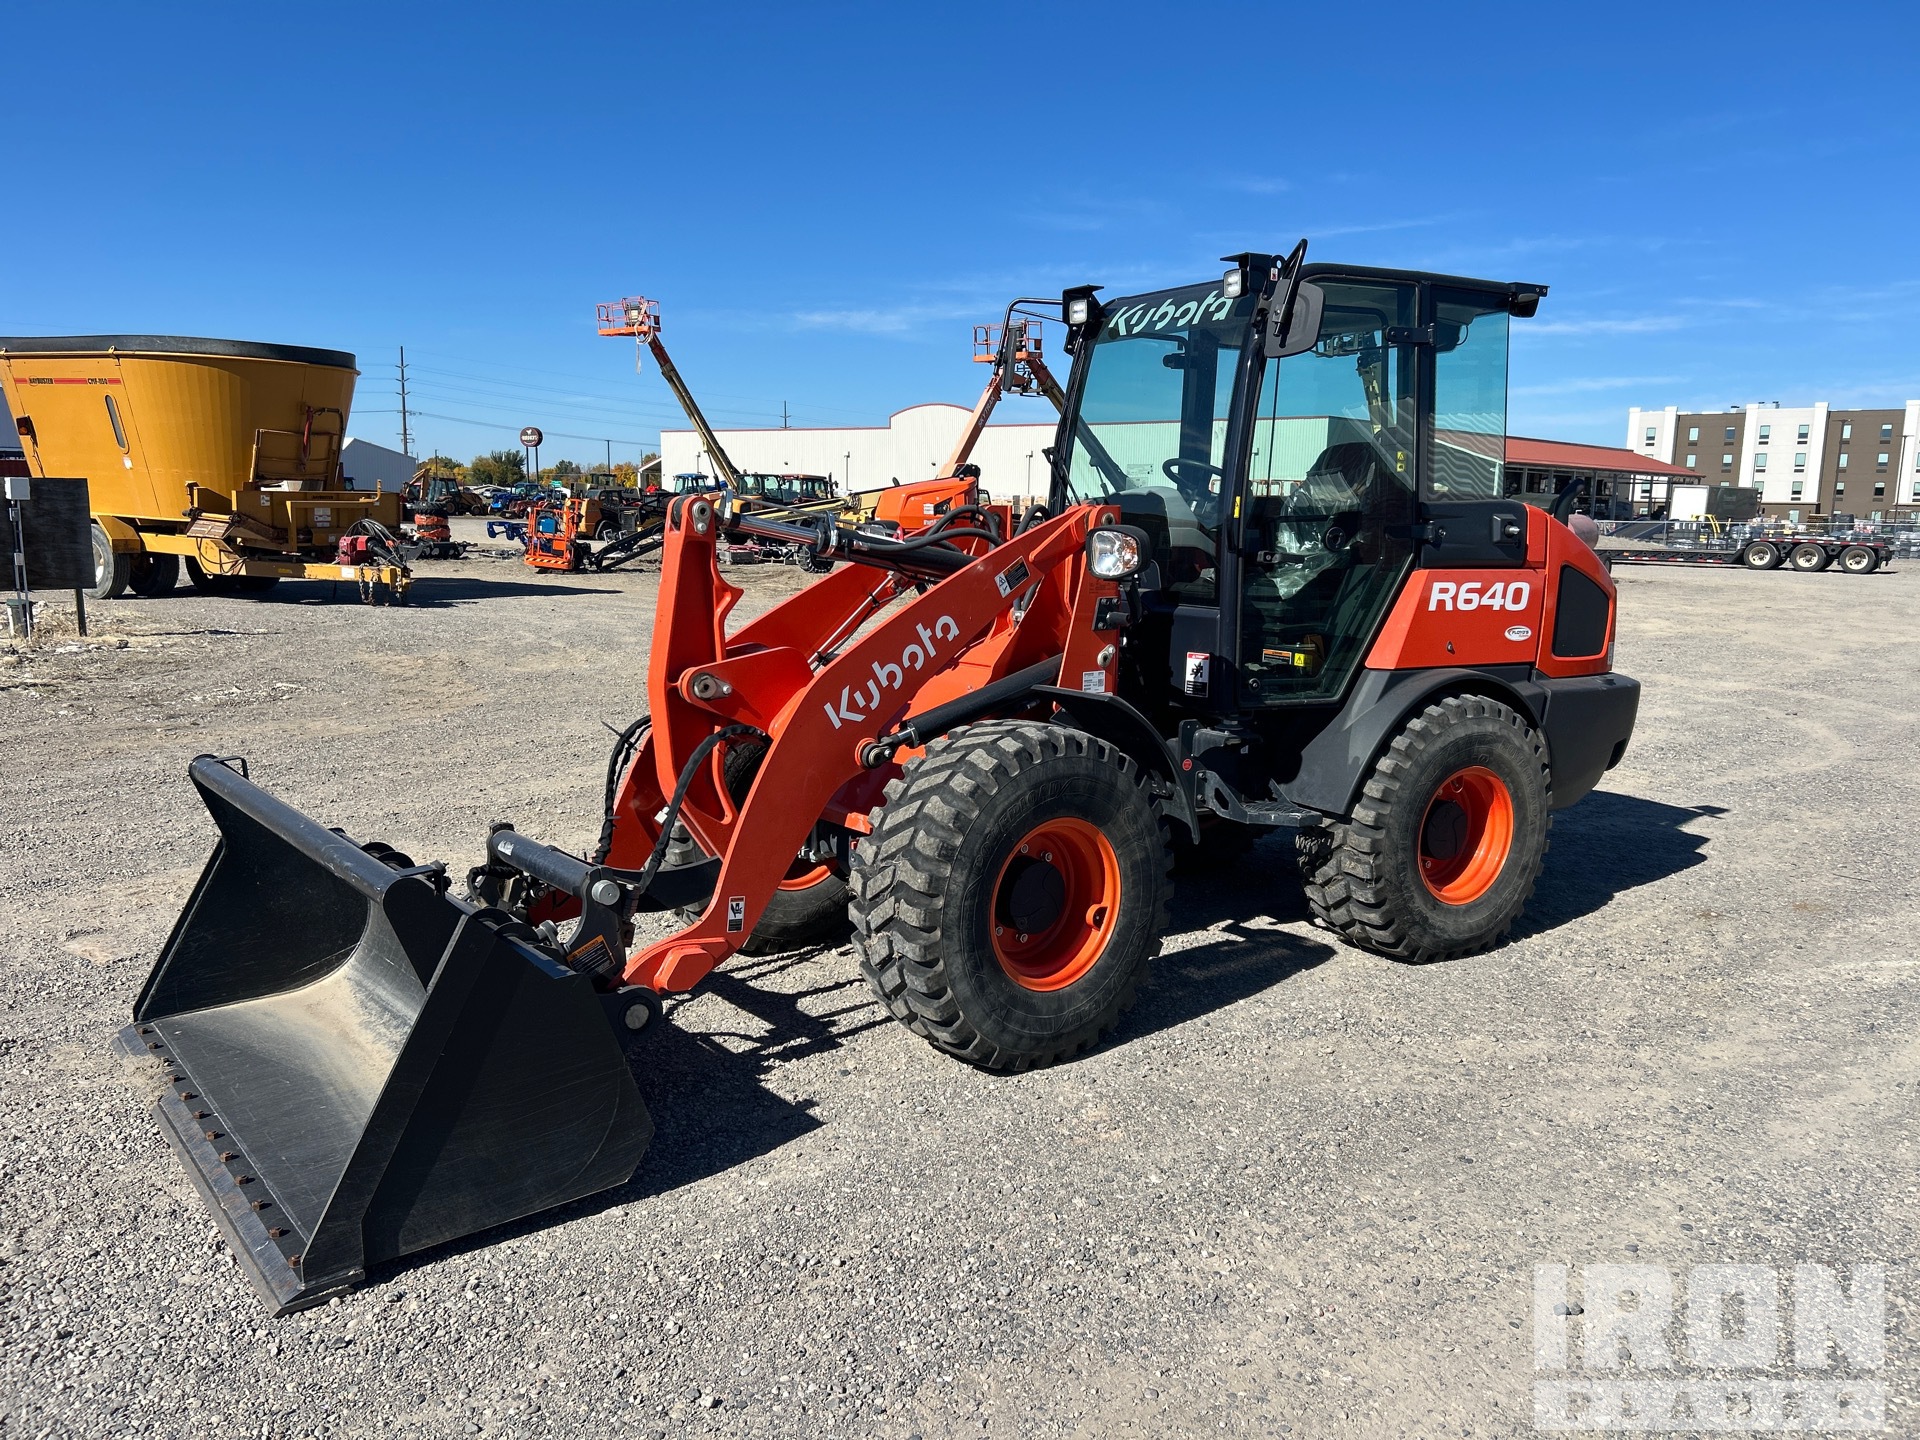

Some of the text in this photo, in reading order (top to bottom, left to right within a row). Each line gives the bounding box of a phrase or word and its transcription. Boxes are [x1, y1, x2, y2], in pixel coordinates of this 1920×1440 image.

[1108, 290, 1234, 336] Kubota
[1427, 581, 1531, 612] R640
[823, 615, 960, 730] Kubota
